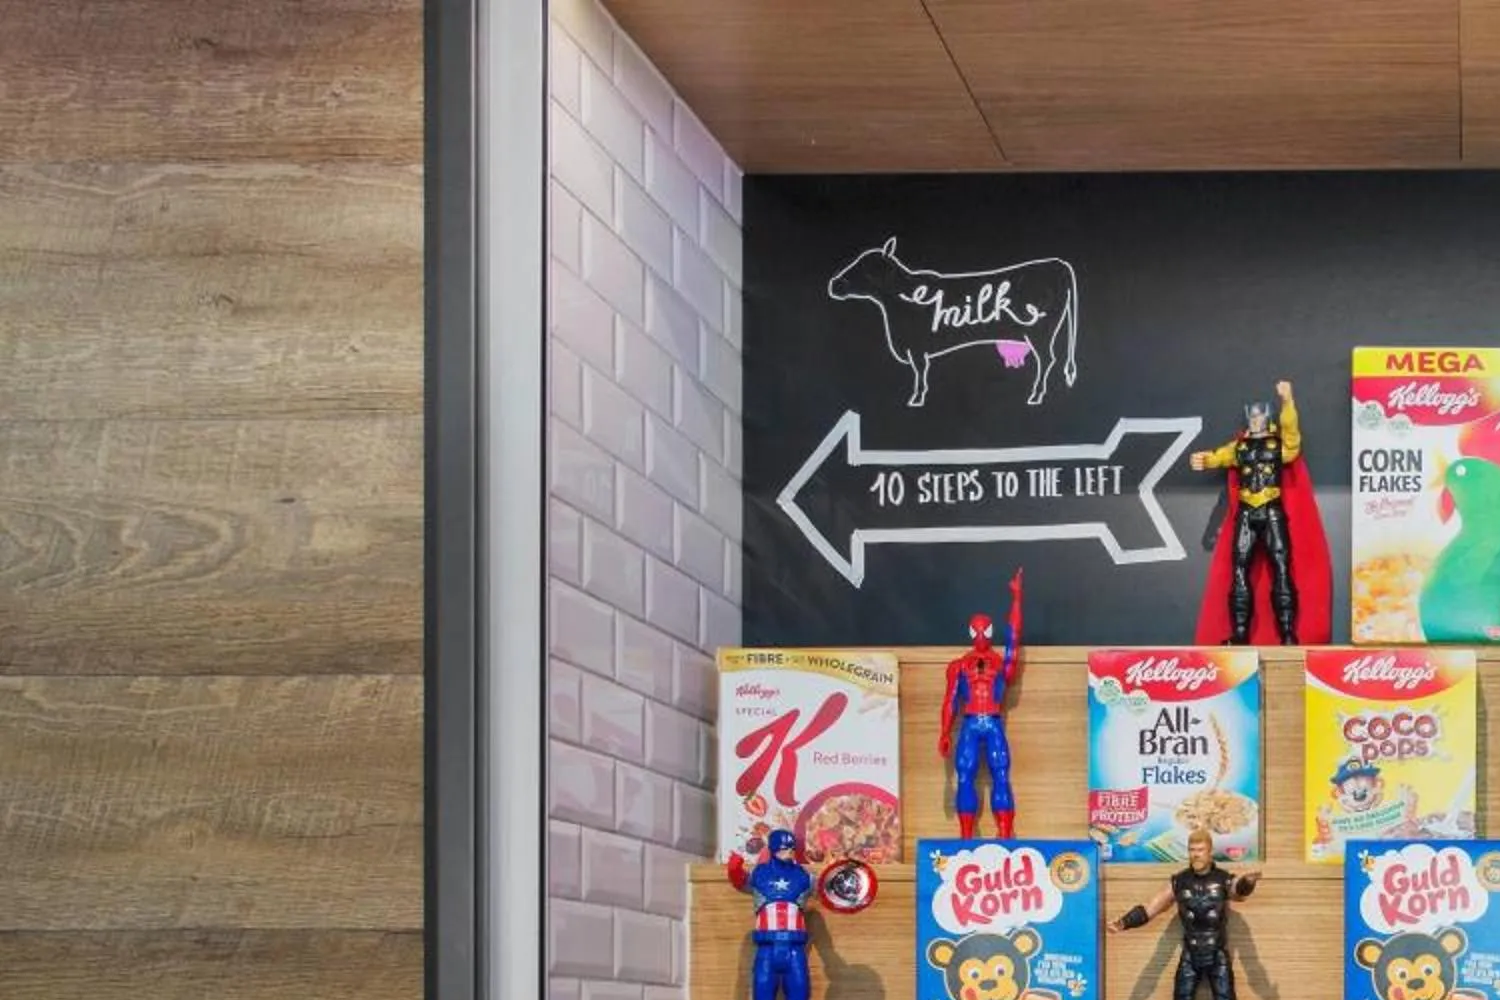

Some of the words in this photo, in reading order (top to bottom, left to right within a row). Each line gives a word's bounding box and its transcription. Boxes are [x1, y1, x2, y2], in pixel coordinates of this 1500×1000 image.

[901, 281, 1045, 331] milk
[1386, 351, 1485, 373] MEGA
[1388, 380, 1481, 417] Kellogg's
[1358, 448, 1423, 473] CORN
[870, 471, 904, 506] 10
[917, 469, 985, 504] STEPS
[991, 470, 1019, 498] TO
[1027, 466, 1063, 498] THE
[1075, 465, 1124, 497] LEFT
[1358, 475, 1423, 494] FLAKES
[746, 653, 785, 665] FIBRE
[807, 655, 894, 685] WHOLEGRAIN
[1126, 656, 1221, 692] Kellogg's
[1342, 655, 1437, 689] Kellogg's
[735, 691, 849, 808] K
[813, 750, 839, 765] Red
[842, 752, 888, 766] Berries
[1138, 729, 1209, 756] Bran
[1141, 765, 1207, 785] Flakes
[1091, 808, 1146, 823] PROTEIN
[955, 854, 1034, 897] Guld
[1383, 855, 1461, 897] Guld
[951, 886, 1044, 927] Korn
[1378, 885, 1471, 928] Korn
